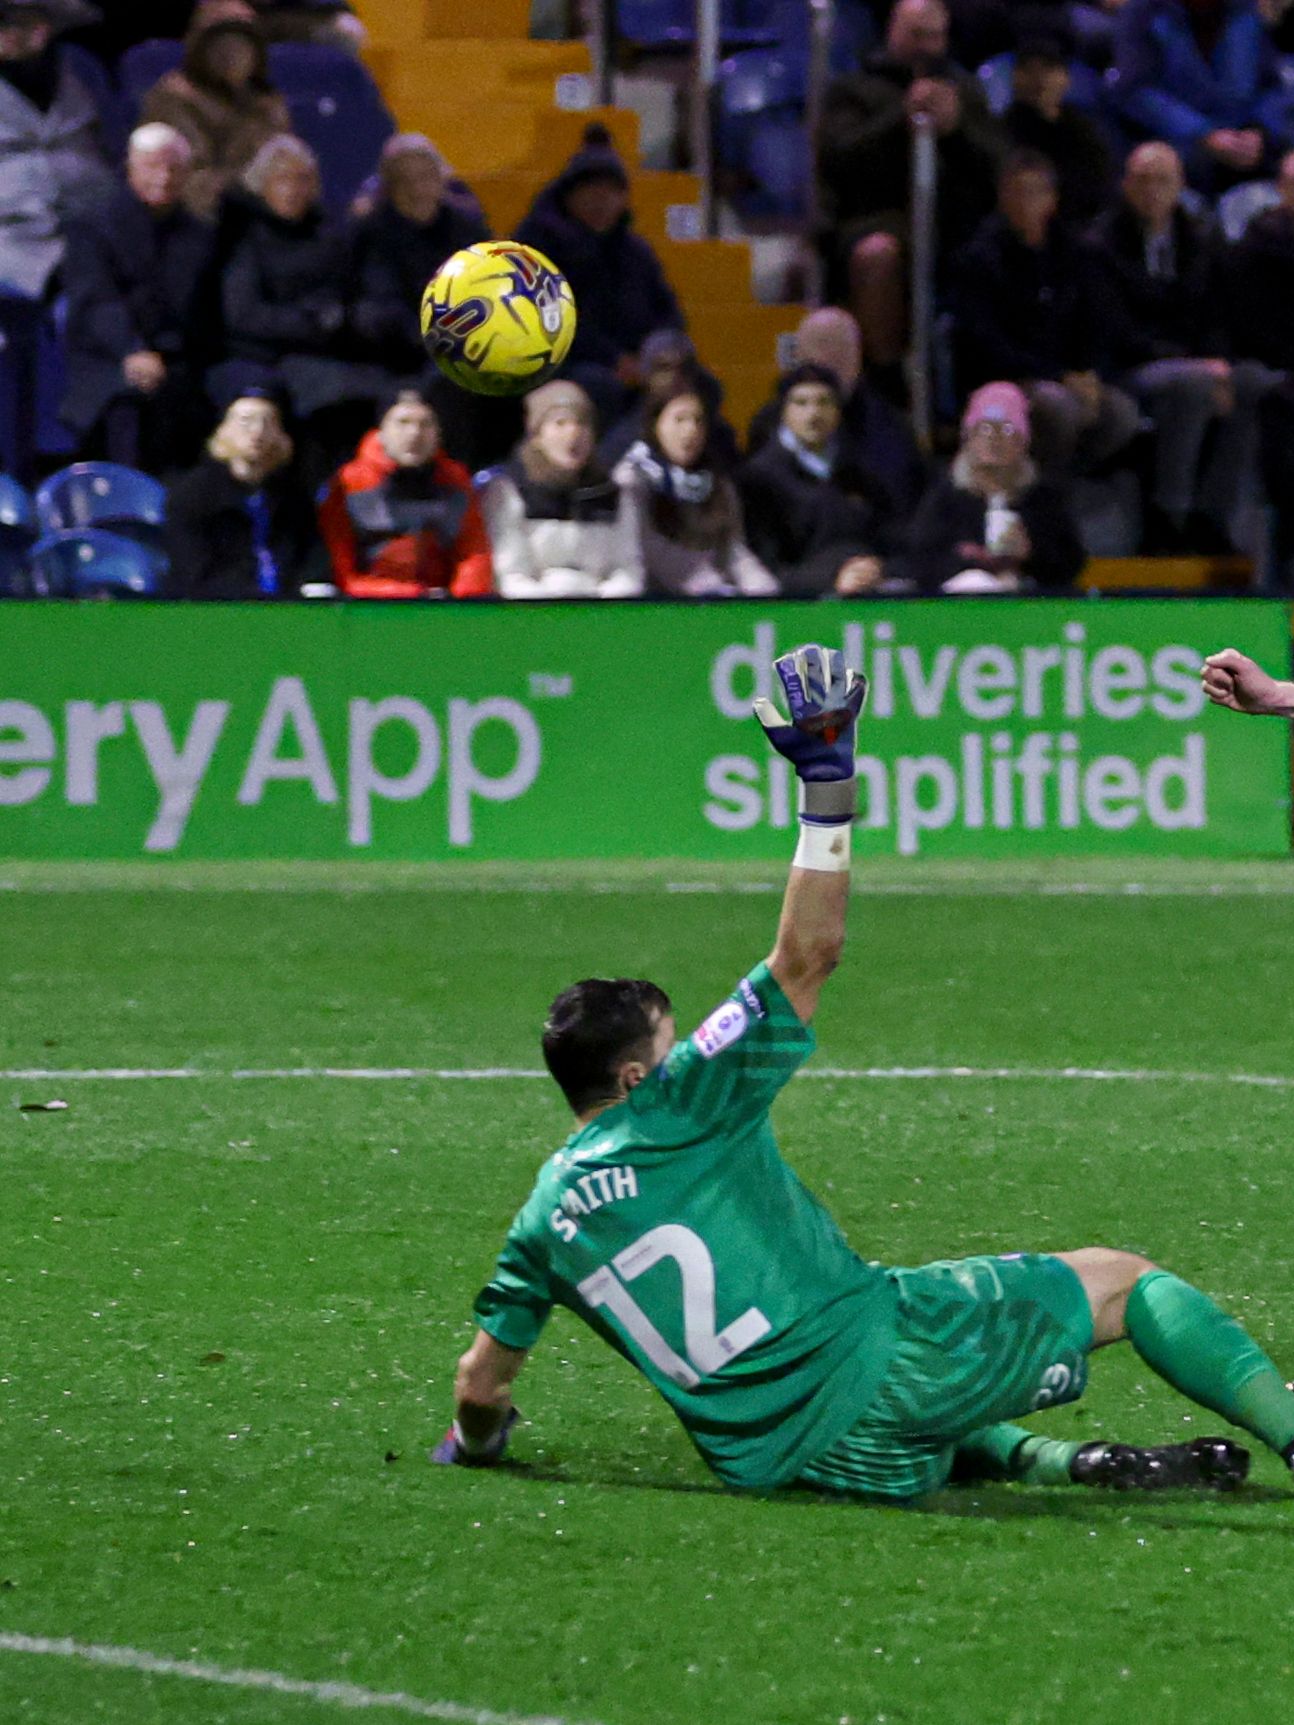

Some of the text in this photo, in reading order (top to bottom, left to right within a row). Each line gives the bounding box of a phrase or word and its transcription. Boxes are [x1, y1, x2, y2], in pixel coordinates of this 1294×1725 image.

[710, 621, 1207, 720] dliveries
[237, 676, 542, 847] App
[550, 1165, 639, 1243] SMITH
[576, 1223, 773, 1388] 12
